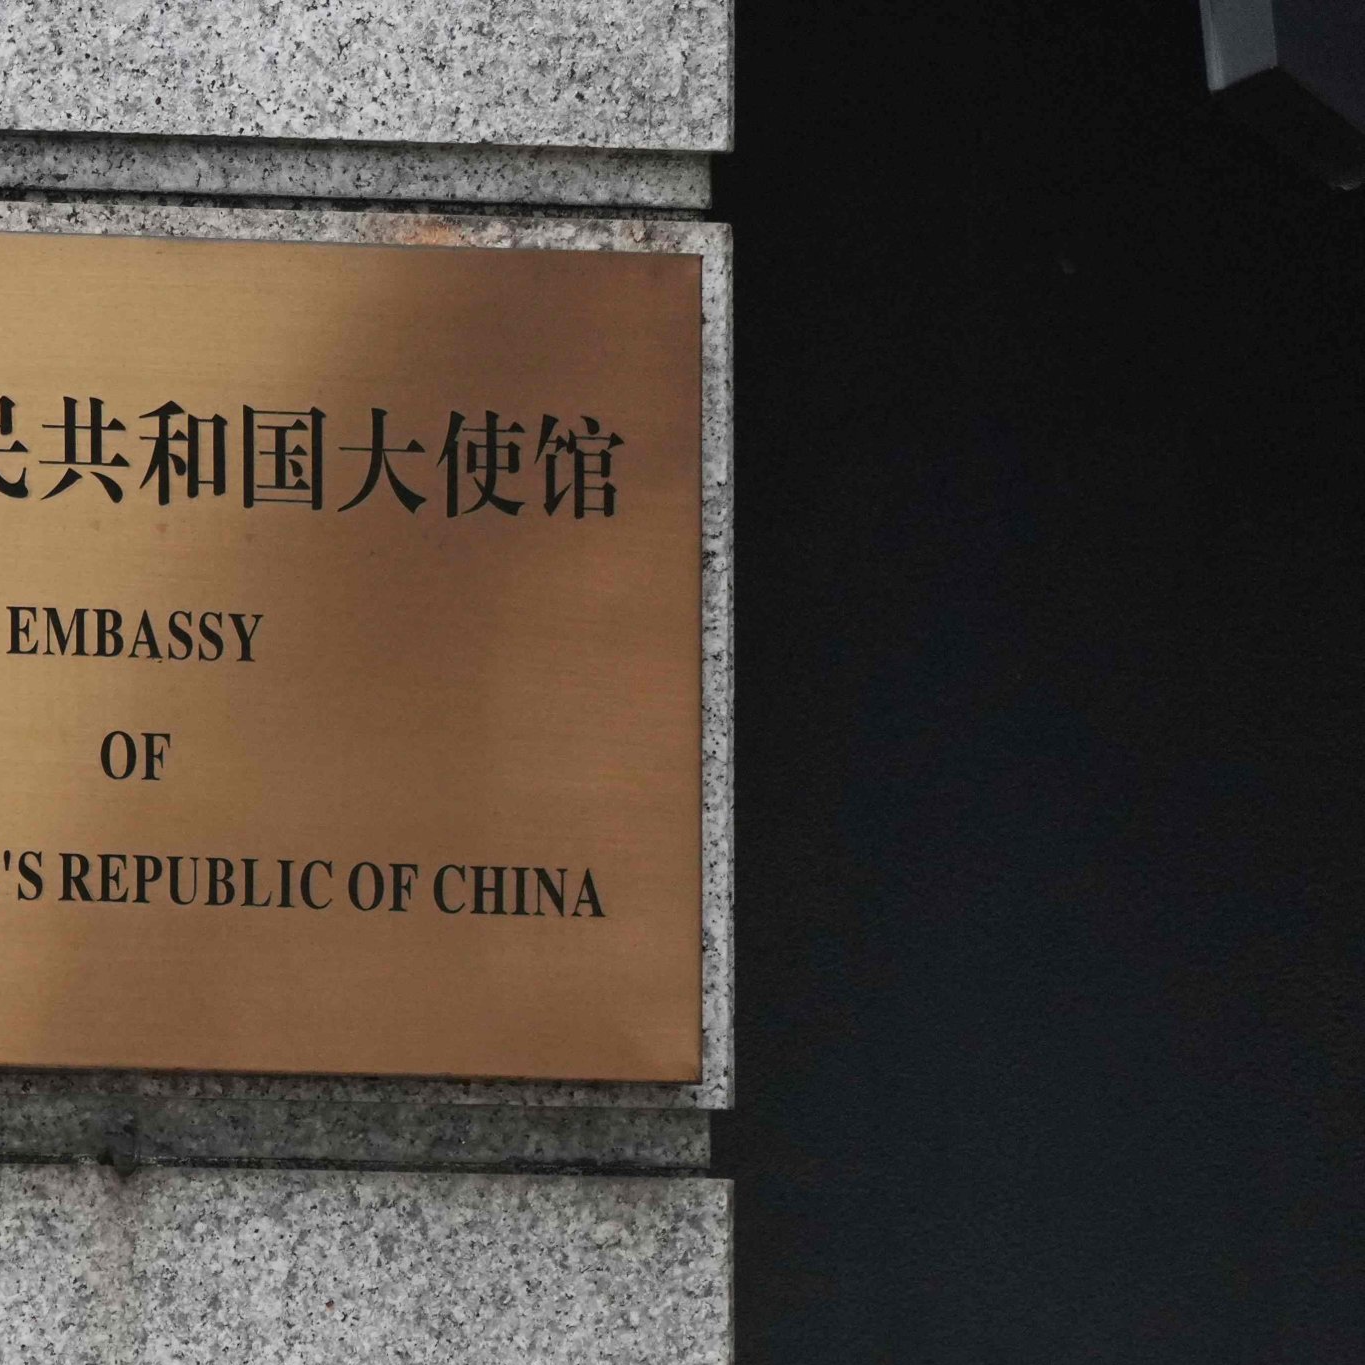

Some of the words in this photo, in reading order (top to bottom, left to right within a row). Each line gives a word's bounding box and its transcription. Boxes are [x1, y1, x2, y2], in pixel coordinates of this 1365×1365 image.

[6, 606, 264, 662] EMBASSY
[100, 730, 171, 781] OF
[58, 852, 333, 911] REPUBLIC
[347, 861, 419, 913] OF
[433, 863, 606, 918] CHINA
